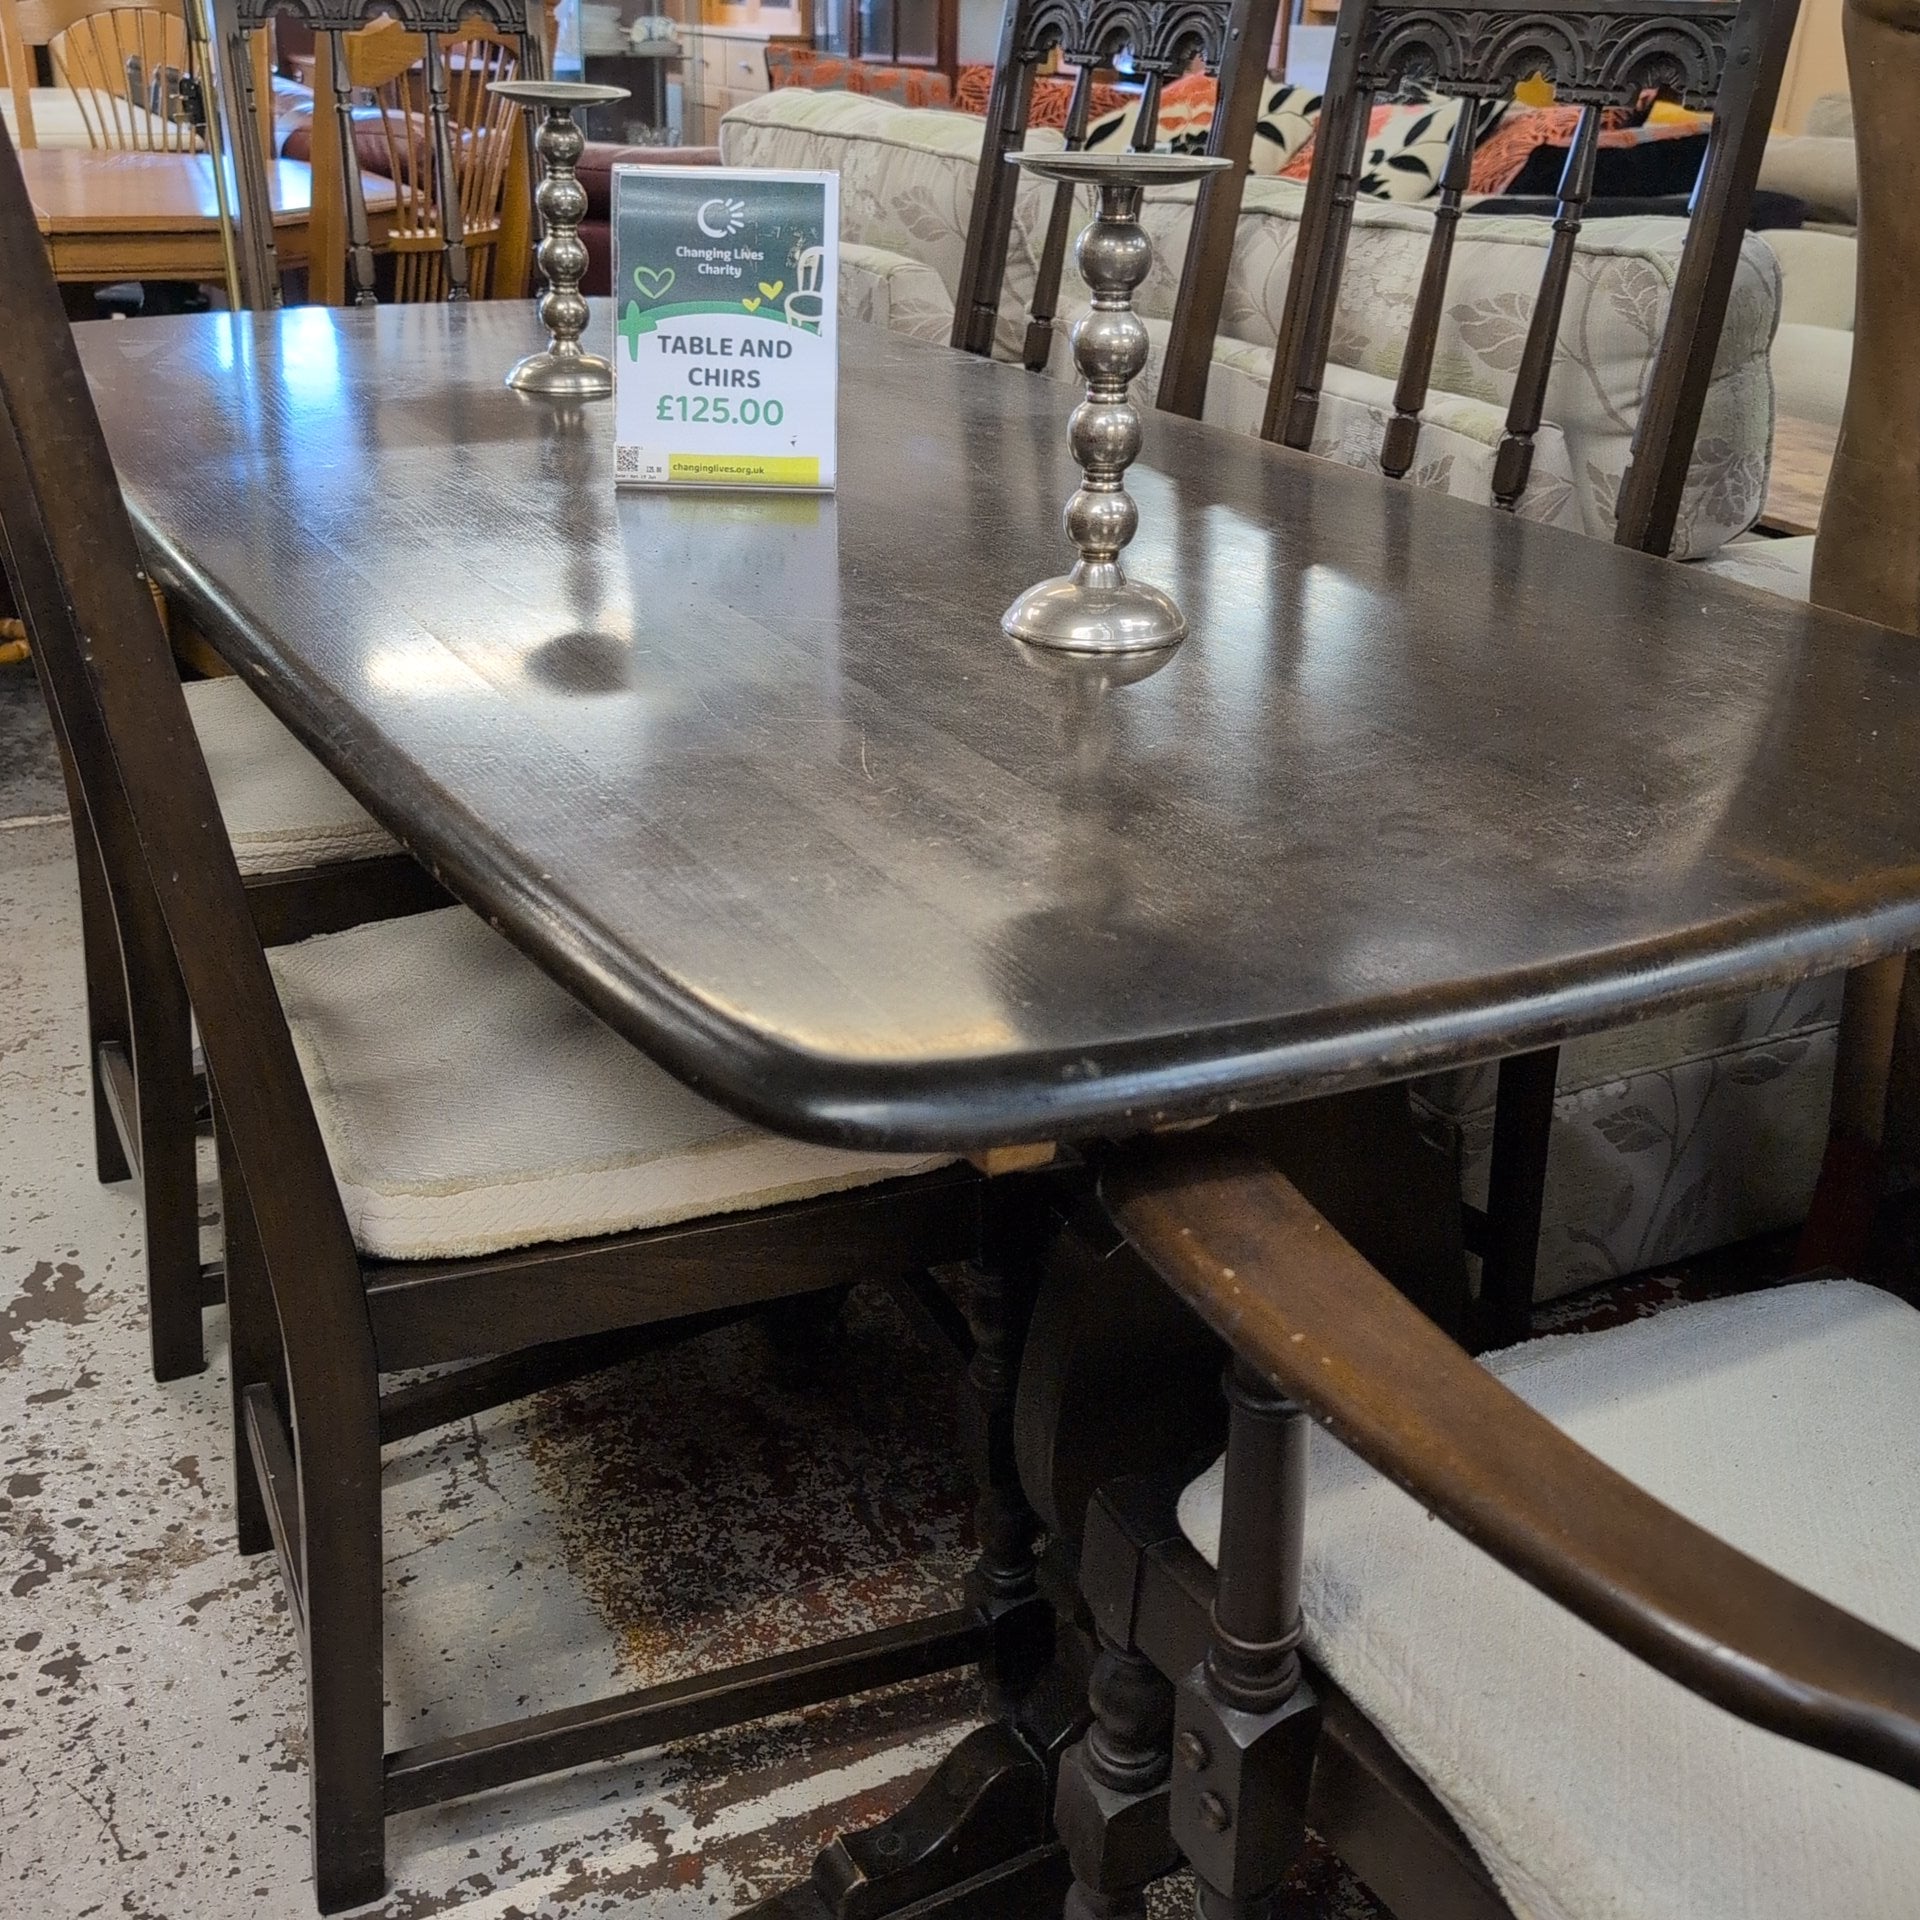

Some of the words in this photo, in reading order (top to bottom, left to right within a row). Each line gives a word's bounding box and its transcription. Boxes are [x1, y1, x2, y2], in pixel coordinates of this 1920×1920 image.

[676, 246, 732, 262] Changing
[734, 248, 765, 261] Lives
[697, 263, 742, 278] Charity
[657, 335, 733, 356] TABLE
[739, 338, 793, 359] AND
[687, 367, 761, 389] CHIRS
[656, 394, 784, 426] £125.00
[672, 463, 765, 476] changinglives.org.uk
